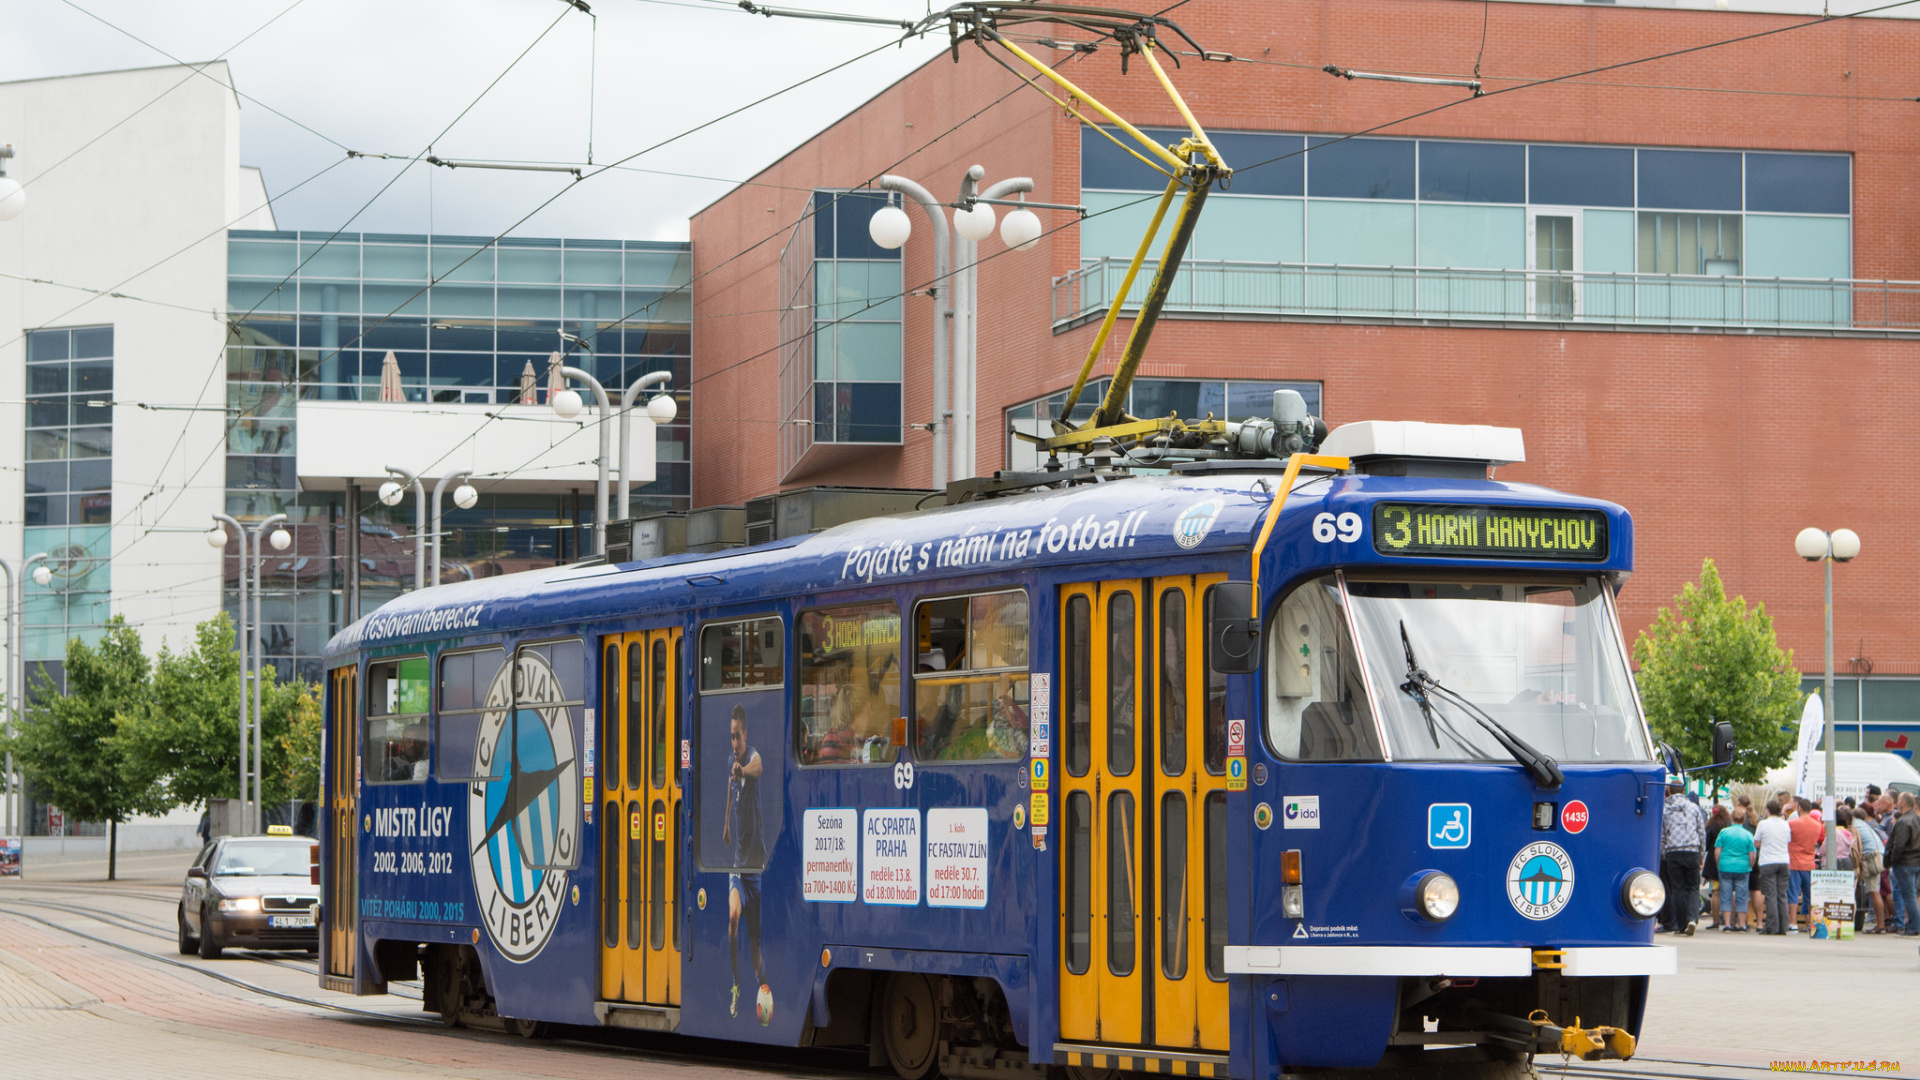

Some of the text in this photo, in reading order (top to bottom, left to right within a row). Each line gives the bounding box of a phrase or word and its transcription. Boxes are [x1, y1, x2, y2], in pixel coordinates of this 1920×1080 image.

[1312, 511, 1363, 543] 69
[1384, 506, 1596, 550] 3 HORNÍ HANYCHOV
[842, 539, 913, 583] Pojďte
[917, 542, 932, 571] s
[1000, 529, 1032, 560] na
[1036, 511, 1148, 554] fotbal!
[822, 614, 834, 653] 3
[472, 664, 560, 798] FC SLOVAN
[893, 762, 914, 789] 69
[375, 806, 453, 837] MISTR LIGY
[817, 815, 843, 829] Sezóna
[1300, 808, 1318, 819] idol
[1564, 812, 1587, 822] 1435
[867, 817, 916, 836] AC SPARTA
[954, 823, 966, 833] kolo
[815, 837, 846, 853] 2017/18:
[876, 840, 907, 858] PRAHA
[928, 840, 987, 859] FC FASTAV ZLÍN
[373, 851, 453, 876] 2002, 2006, 2012
[806, 857, 854, 876] permanentky
[1514, 845, 1569, 870] FC SLOVAN
[870, 866, 912, 882] neděle 13.8.
[934, 865, 980, 881] neděle 30.7.
[488, 828, 571, 947] LIBEREC
[804, 882, 812, 894] za
[847, 880, 856, 894] Kč
[865, 884, 917, 901] od 18:00 hodin
[930, 884, 985, 900] od 17:00 hodin
[361, 894, 465, 922] VÍTĚZ POHÁRU 2000, 2015
[1514, 894, 1565, 916] LIBEREC
